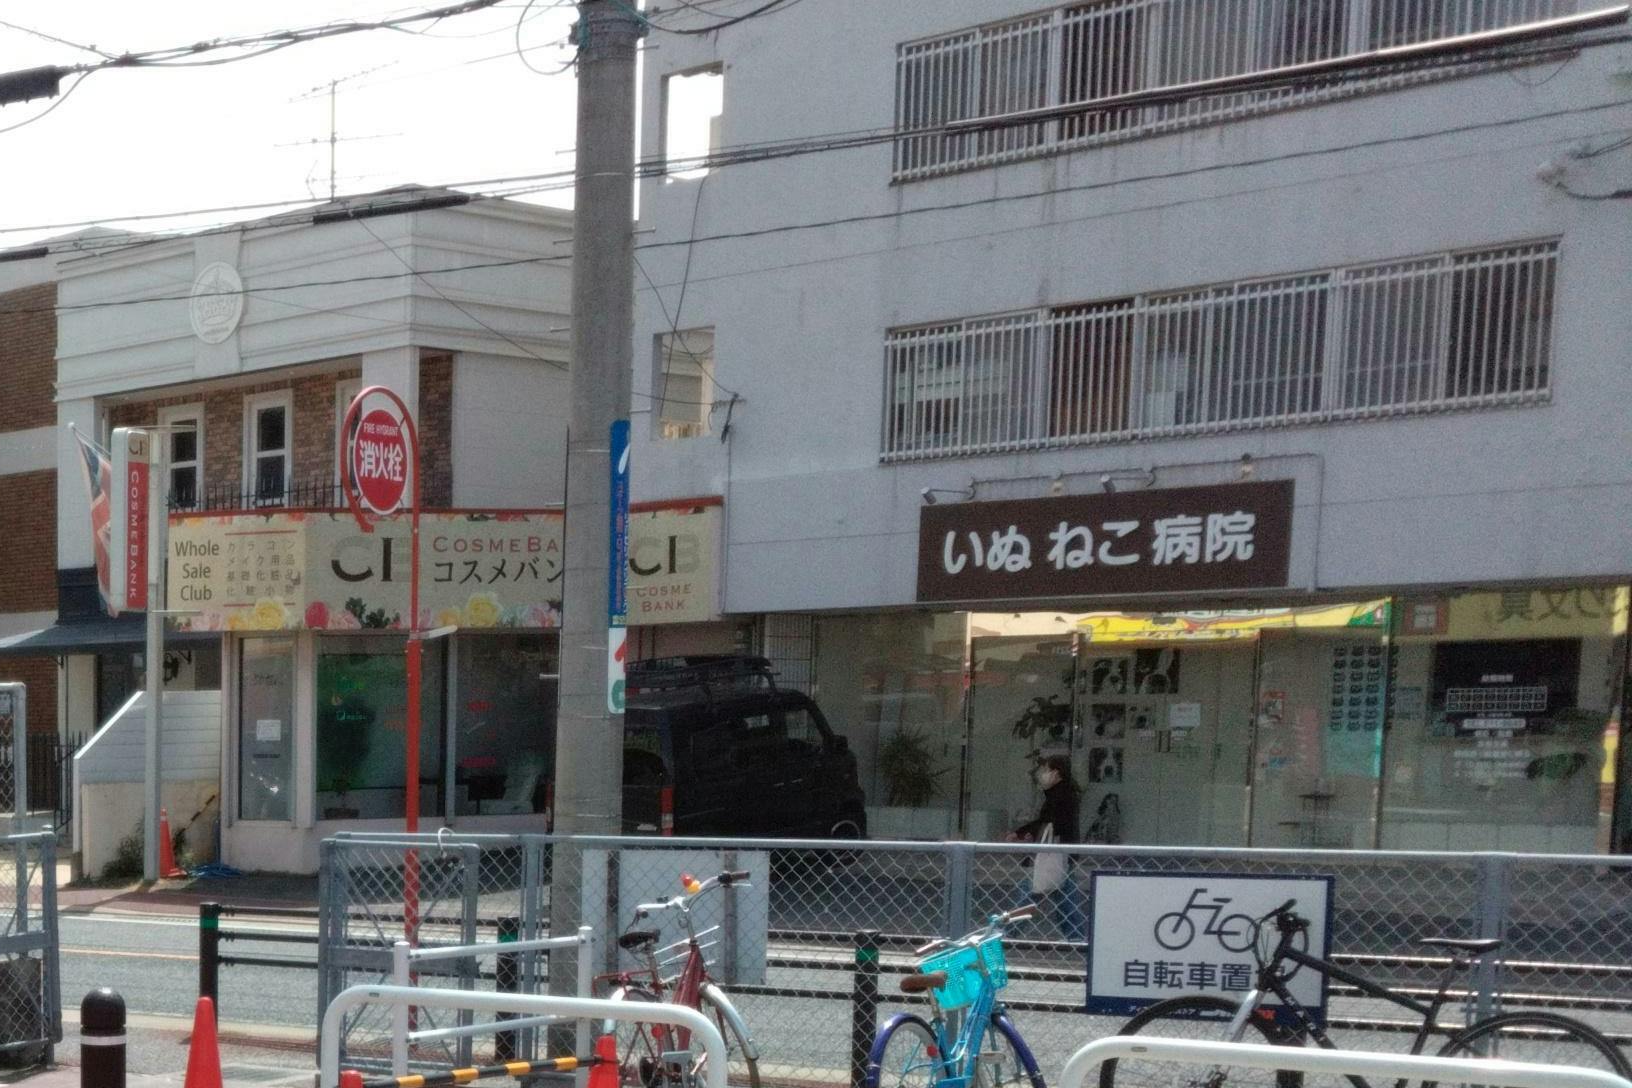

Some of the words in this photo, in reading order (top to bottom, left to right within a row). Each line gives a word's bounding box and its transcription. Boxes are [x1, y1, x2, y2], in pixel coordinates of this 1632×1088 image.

[359, 440, 404, 481] 消火栓
[175, 540, 219, 557] Whole
[432, 535, 559, 553] COSMEBA
[943, 525, 1032, 573] いぬ
[1049, 521, 1142, 570] ねこ
[1153, 512, 1256, 565] 病院
[182, 563, 211, 579] Sale
[434, 558, 563, 584] コスメバン
[180, 585, 212, 601] Club
[636, 583, 692, 597] COSME
[641, 599, 686, 613] BANK
[1124, 959, 1260, 992] 自転車置
